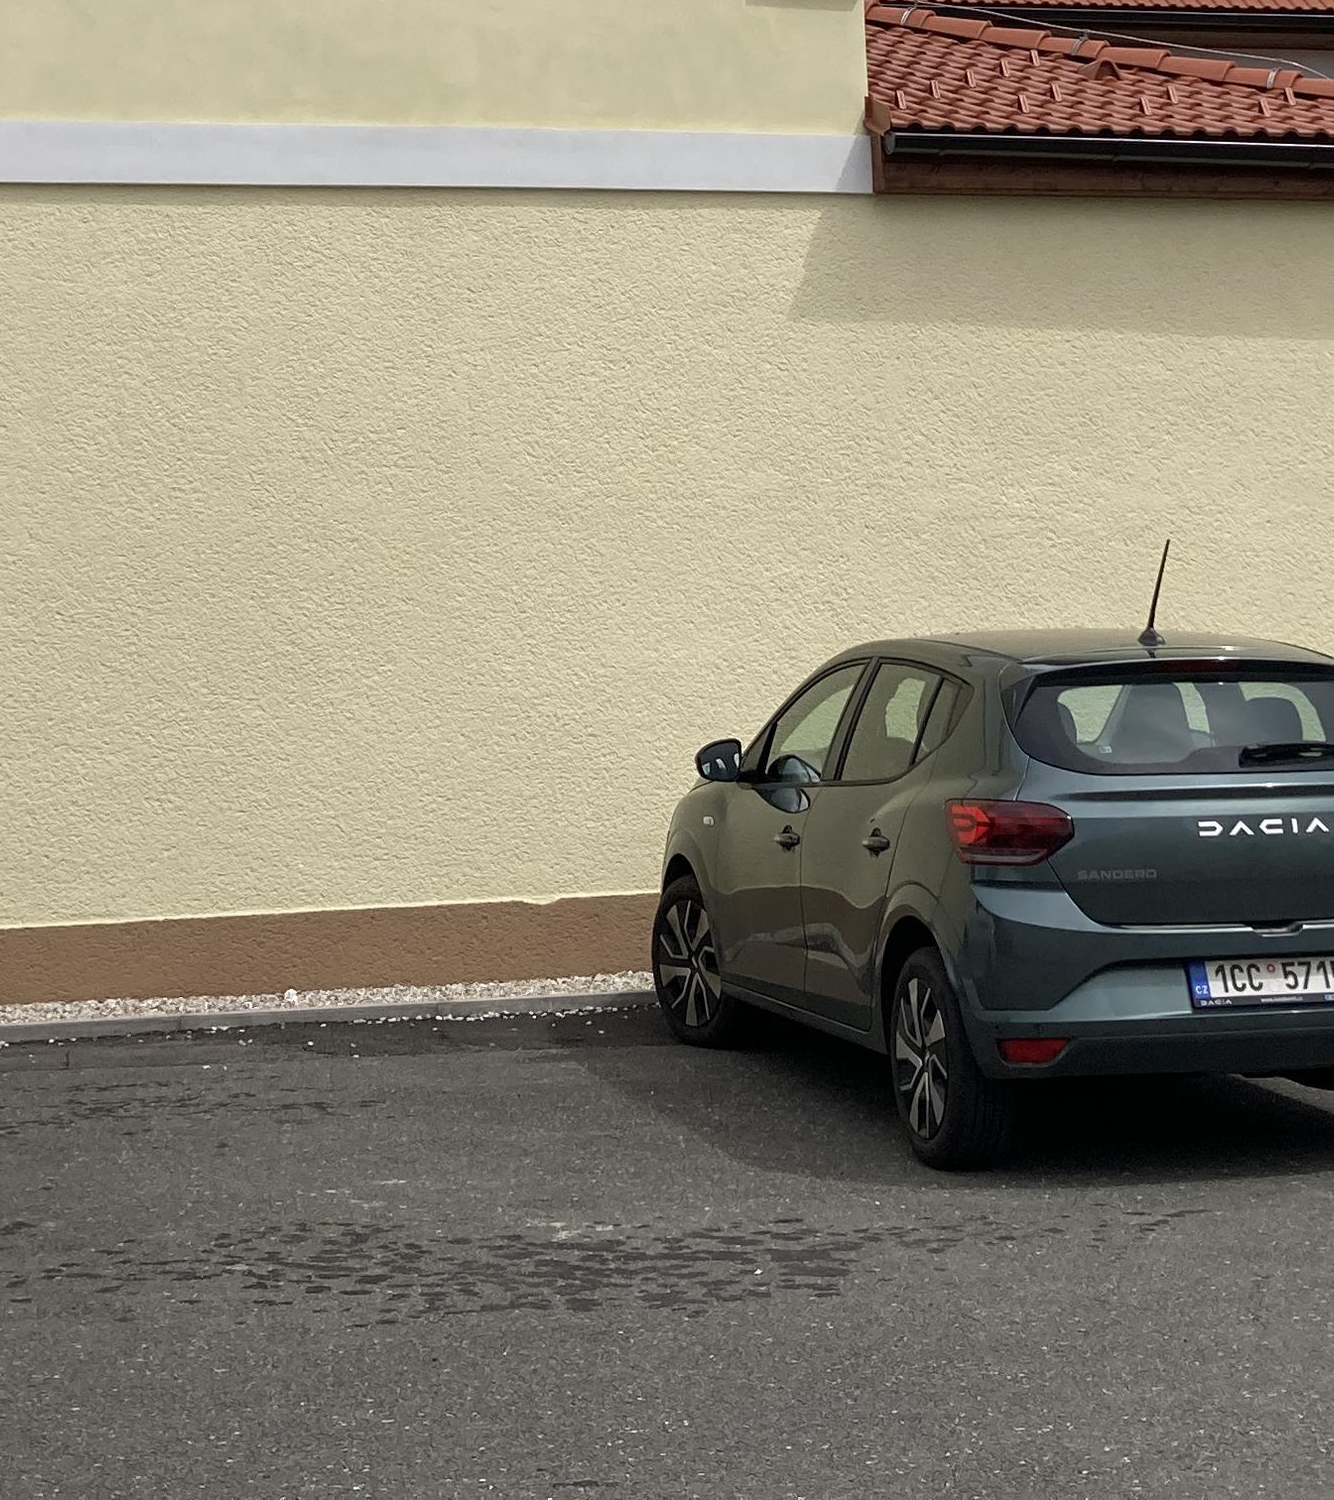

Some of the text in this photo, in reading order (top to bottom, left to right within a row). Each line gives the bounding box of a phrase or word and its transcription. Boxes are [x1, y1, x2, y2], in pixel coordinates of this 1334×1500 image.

[1197, 817, 1330, 837] DACIA
[1077, 869, 1158, 881] SANDERO
[1195, 985, 1209, 995] CZ
[1215, 963, 1264, 993] 1CC
